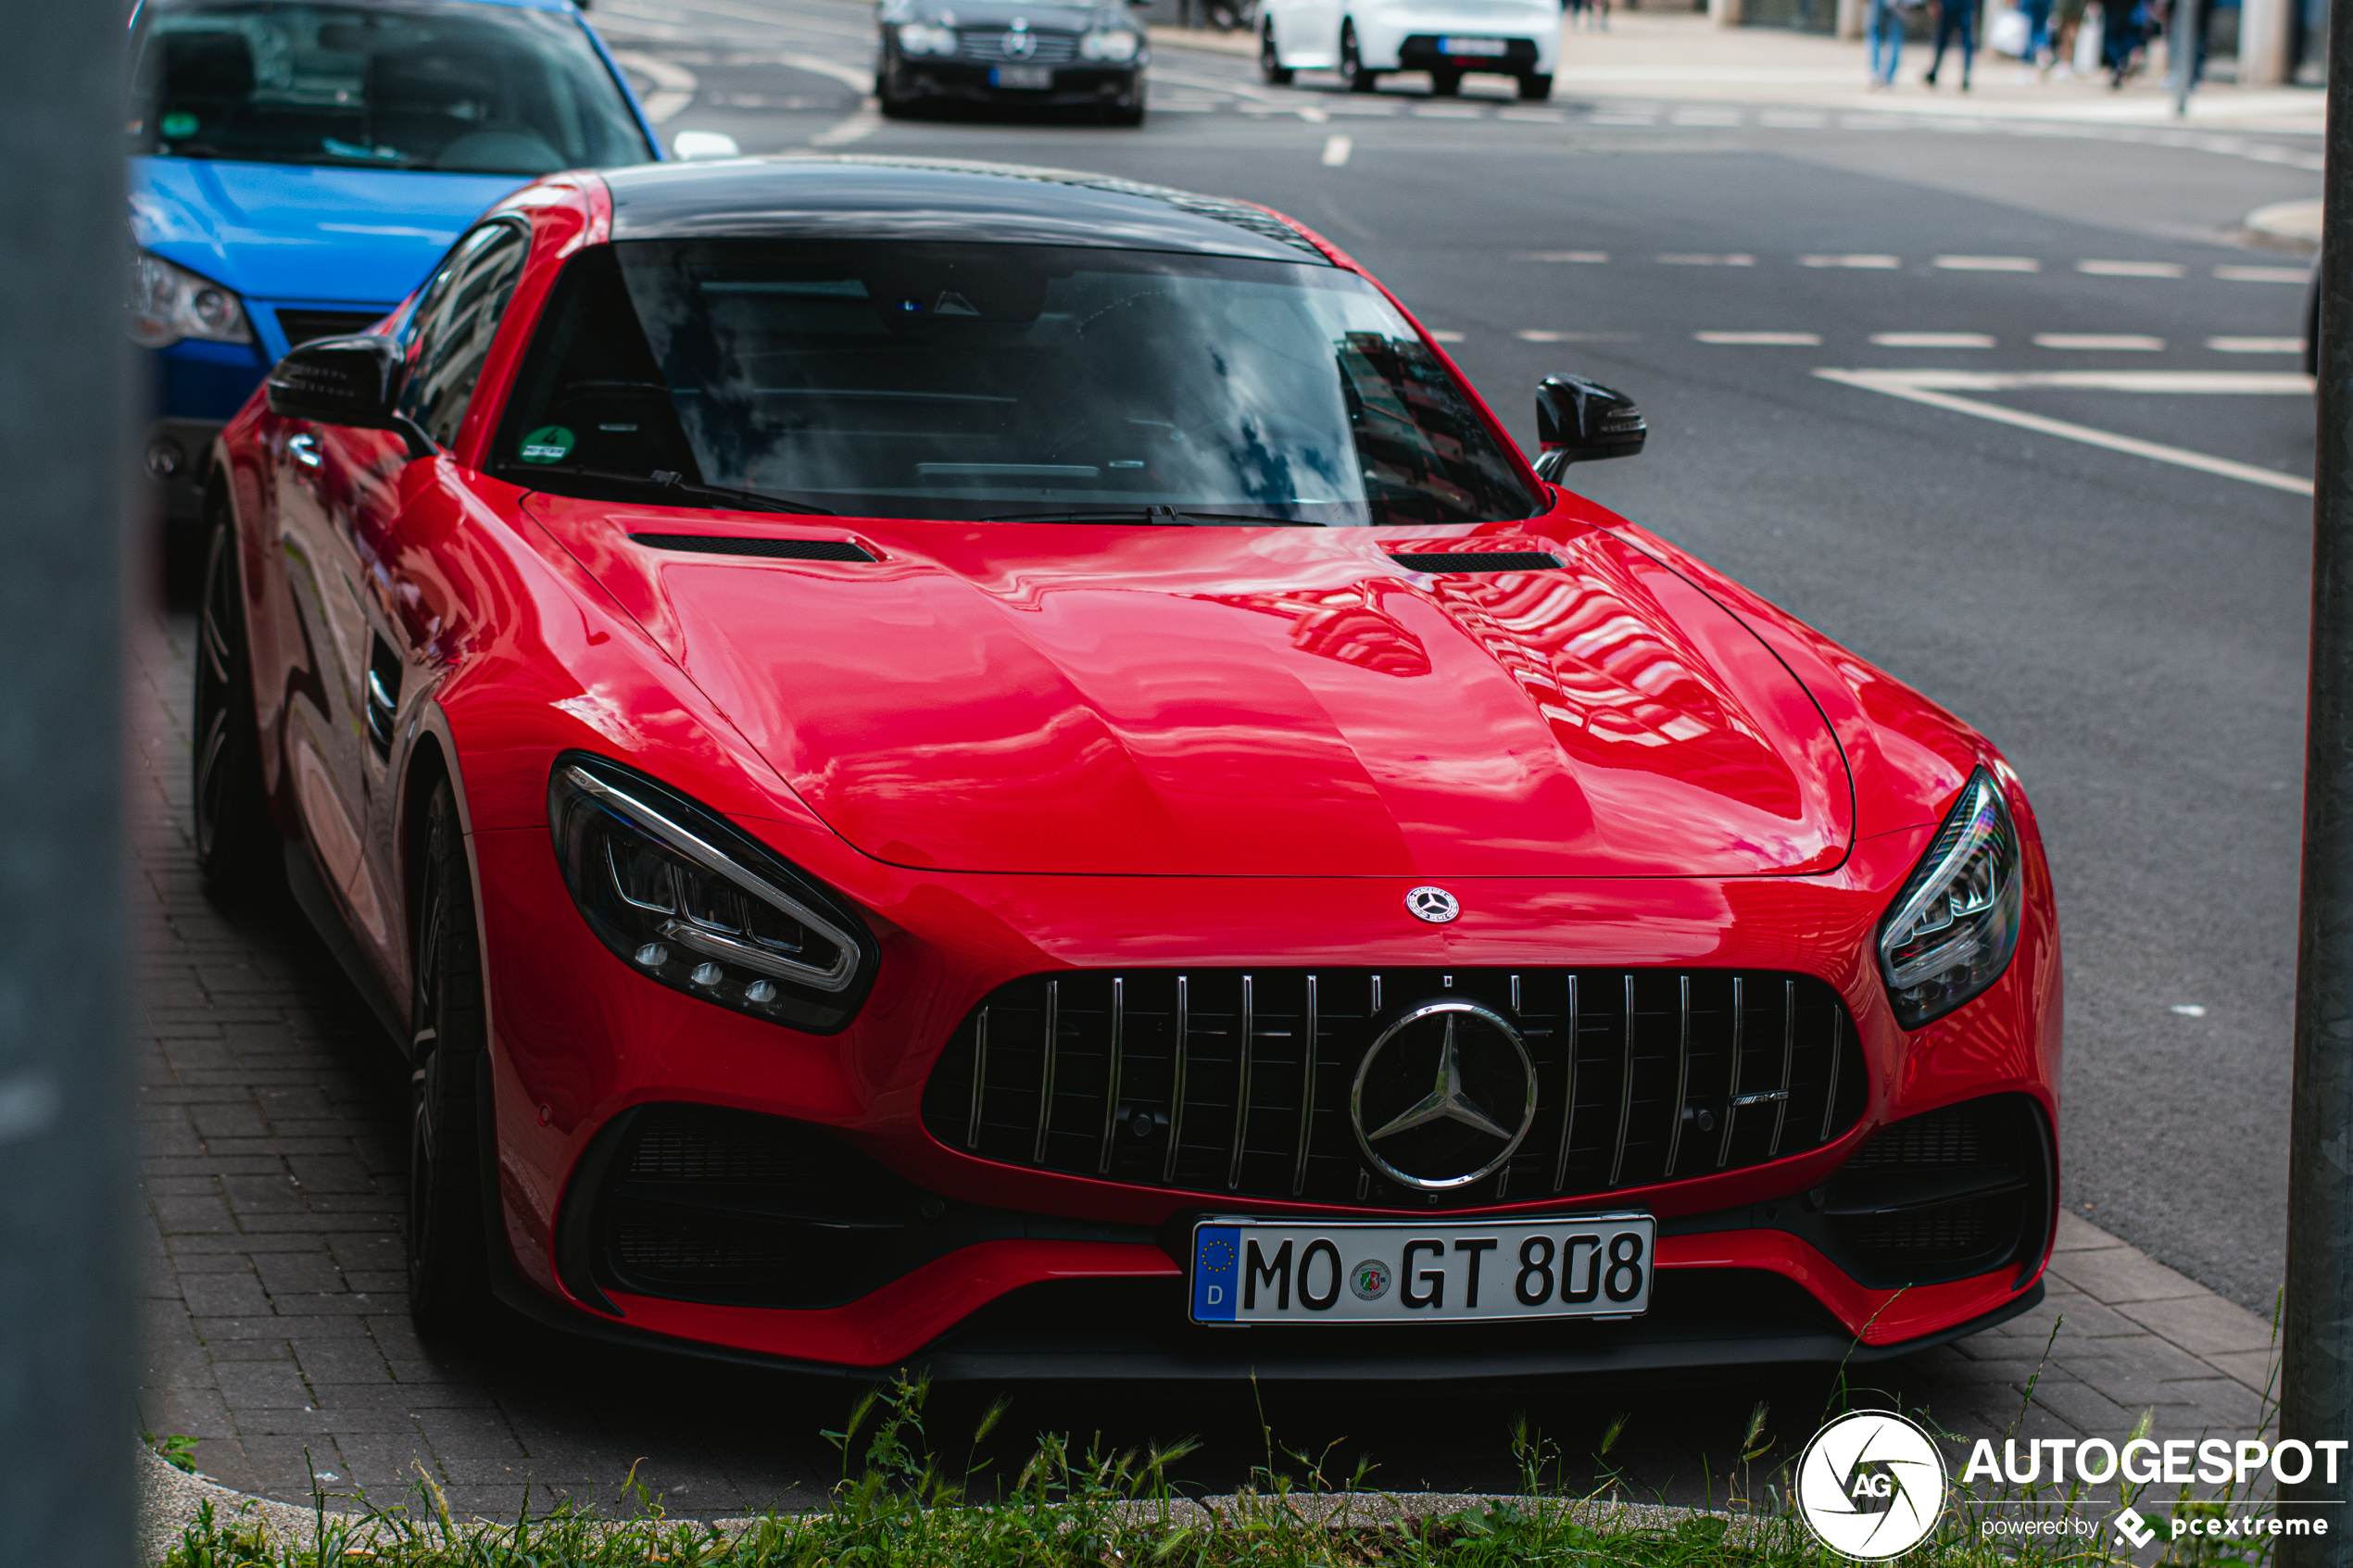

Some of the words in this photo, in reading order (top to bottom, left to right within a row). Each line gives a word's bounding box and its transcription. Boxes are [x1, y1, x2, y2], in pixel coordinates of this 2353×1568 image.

[543, 429, 558, 445] 4
[1750, 1092, 1789, 1103] AMG
[1208, 1286, 1223, 1305] D
[1243, 1236, 1343, 1311] MO
[1399, 1236, 1498, 1310] GT
[1515, 1231, 1644, 1306] 808
